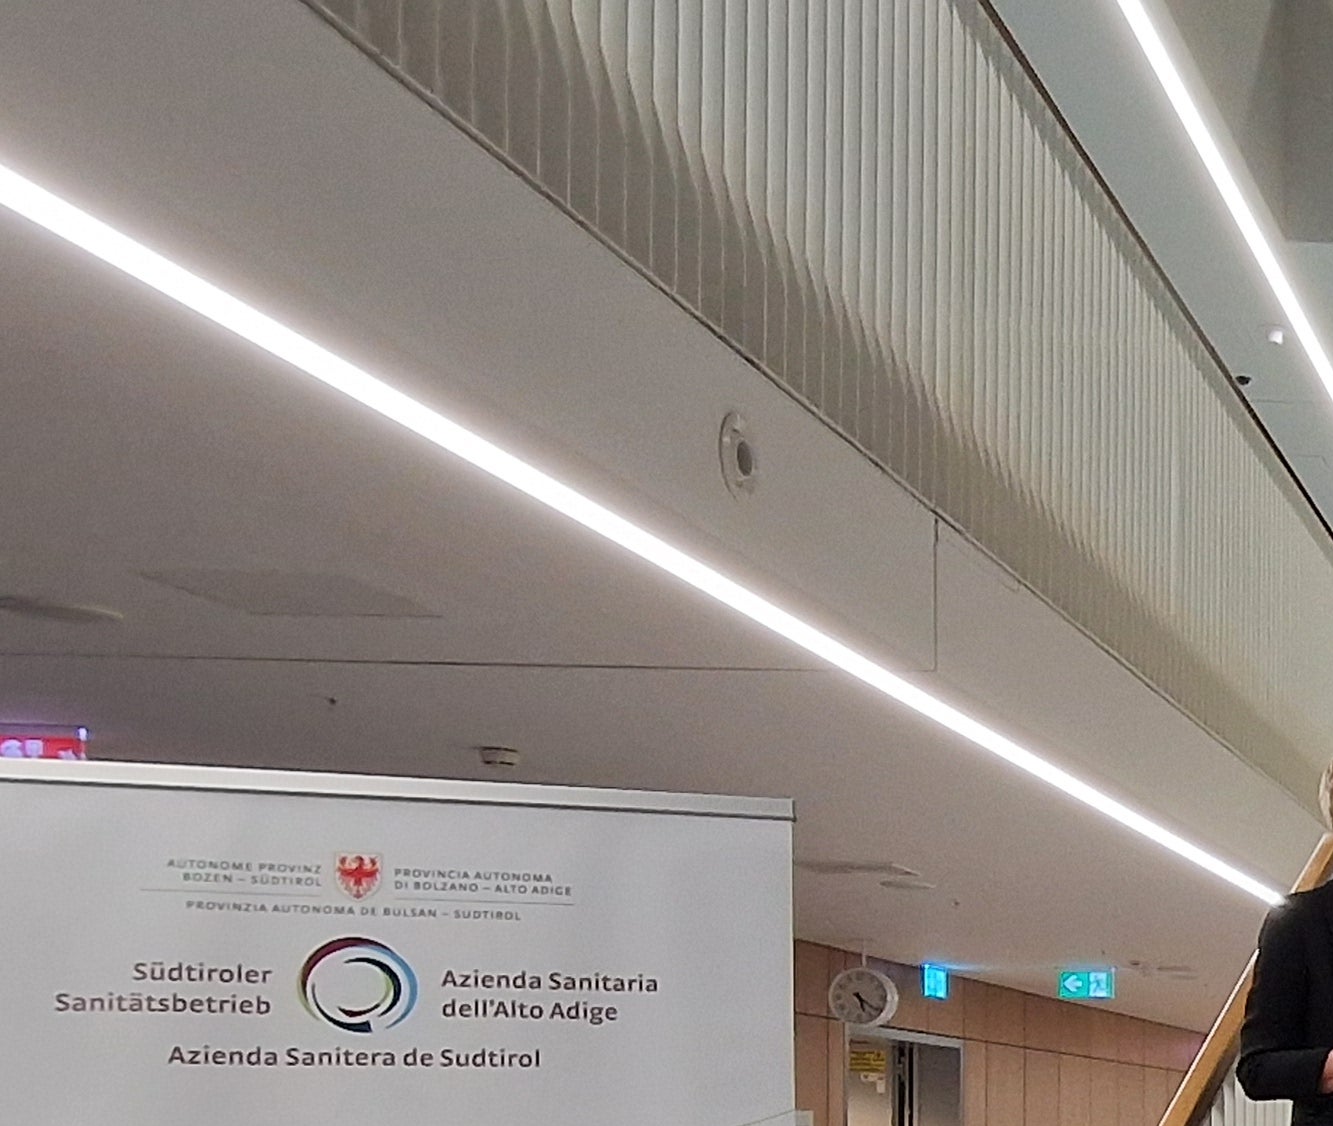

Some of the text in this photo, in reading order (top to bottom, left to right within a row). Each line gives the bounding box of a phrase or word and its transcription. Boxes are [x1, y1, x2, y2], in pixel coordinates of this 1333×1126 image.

[167, 860, 321, 874] AUTONOME PROVINZ
[394, 868, 552, 882] PROVINCIA AUTONOMA
[183, 873, 232, 883] BOZEN
[251, 874, 321, 886] SÜDTIROL
[394, 880, 408, 889] DI
[414, 882, 478, 892] BOLZANO
[495, 885, 527, 894] ALTO
[532, 886, 571, 896] ADIGE
[186, 901, 267, 912] PROVINZIA
[271, 904, 354, 916] AUTONOMA
[360, 907, 376, 916] DE
[383, 908, 436, 917] BULSAN
[454, 910, 520, 920] SUDTIROL
[134, 962, 272, 983] Südtiroler
[442, 970, 657, 992] Azienda Sanitaria
[56, 993, 270, 1014] Sanitätsbetrieb
[443, 999, 617, 1025] dell'Alto Adige
[169, 1045, 539, 1067] Azienda Sanitera de Sudtirol
